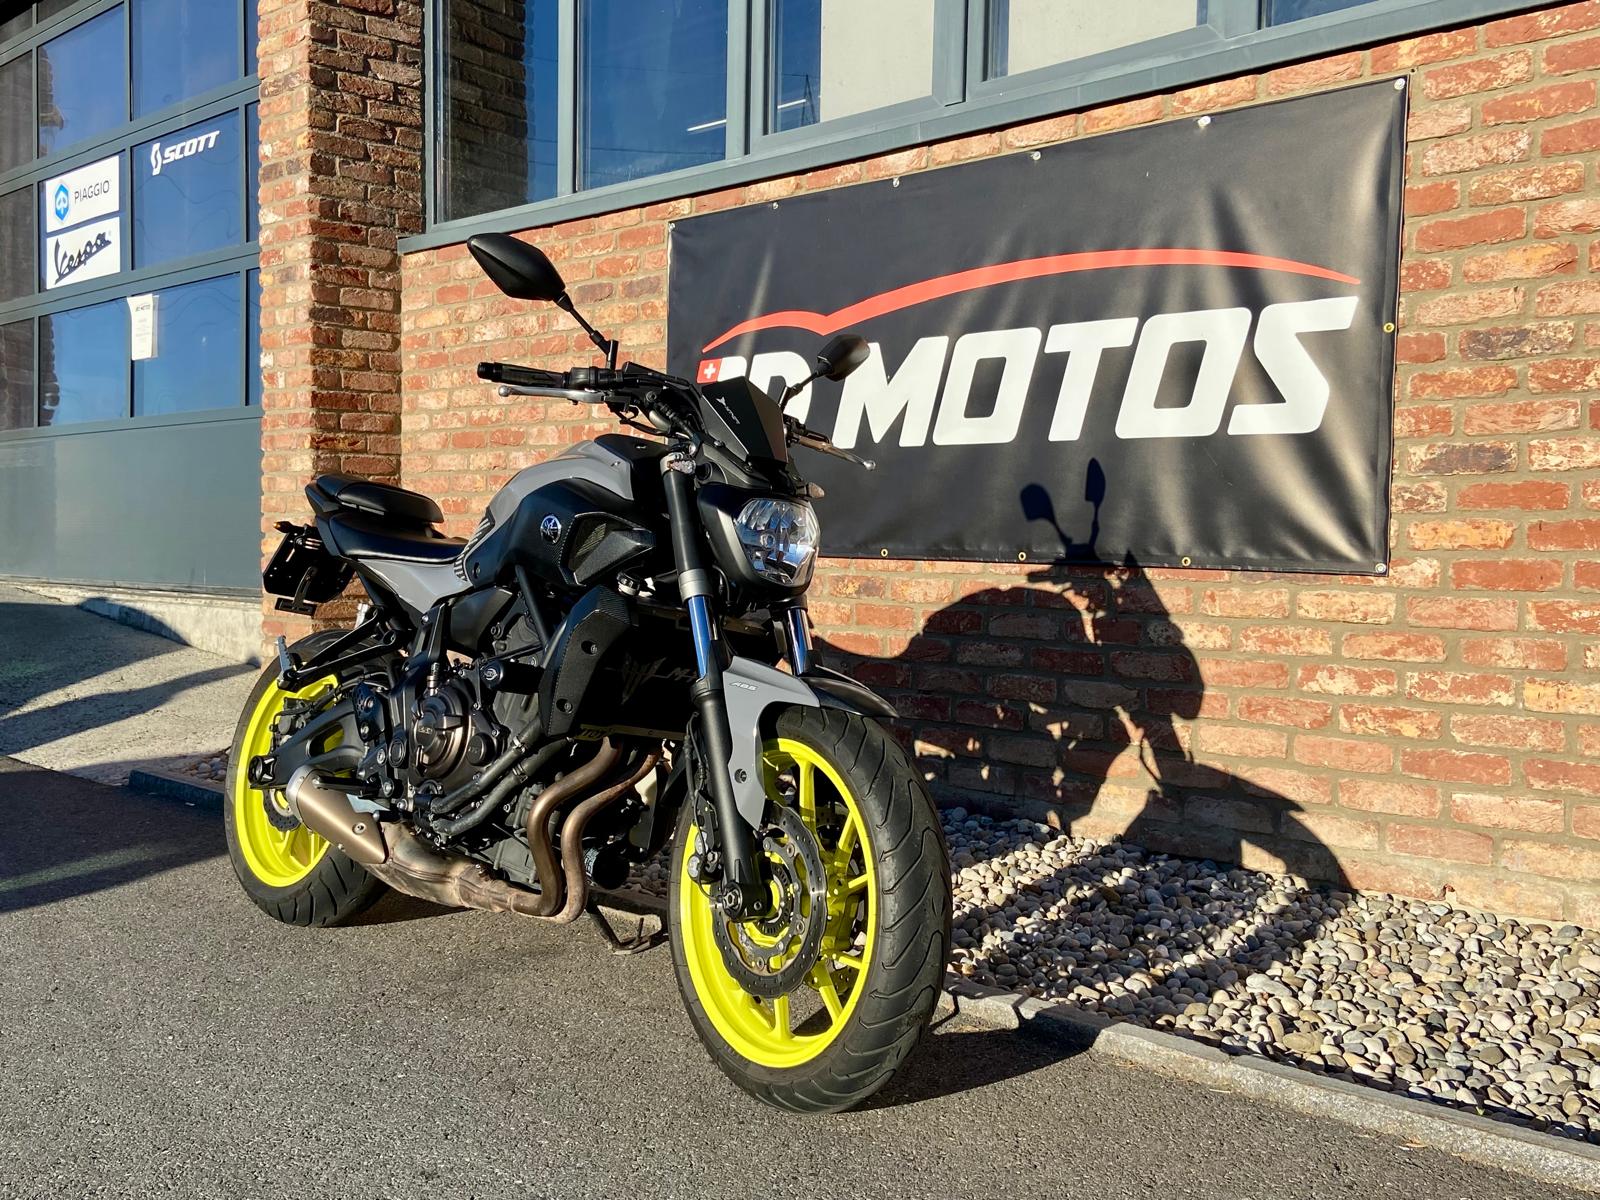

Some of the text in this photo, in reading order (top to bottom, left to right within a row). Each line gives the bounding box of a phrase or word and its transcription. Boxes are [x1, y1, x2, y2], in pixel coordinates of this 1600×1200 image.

[162, 130, 220, 164] SCOTT
[73, 180, 110, 204] PIAGGIO
[54, 231, 112, 285] Vespa
[831, 296, 1359, 449] MOTOS
